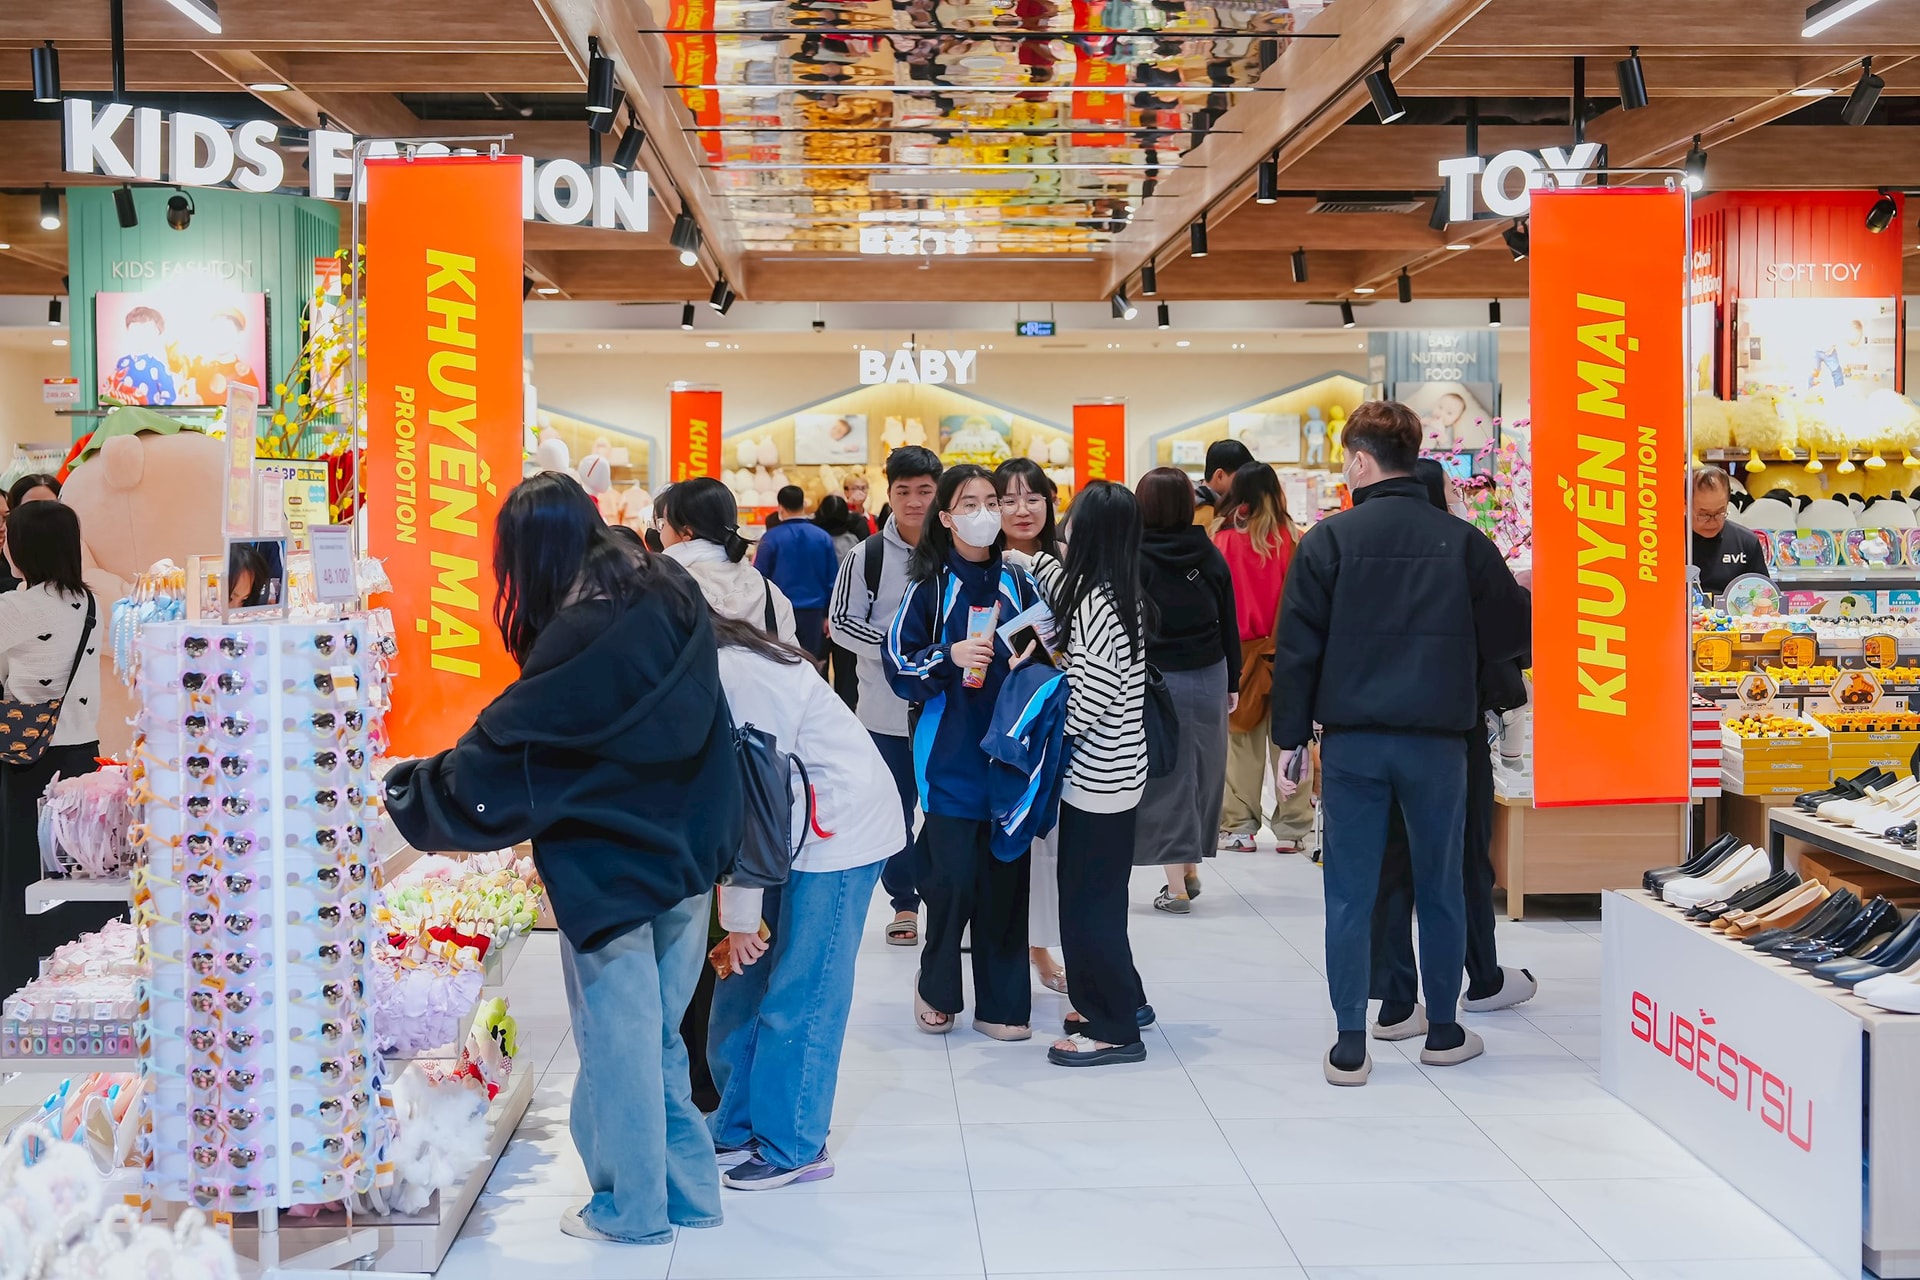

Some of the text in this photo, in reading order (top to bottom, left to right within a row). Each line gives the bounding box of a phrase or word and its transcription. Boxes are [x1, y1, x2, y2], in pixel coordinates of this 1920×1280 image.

[64, 98, 284, 193] KIDS
[1438, 142, 1602, 221] TOY
[112, 260, 154, 279] KIDS
[1766, 263, 1863, 283] SOFT TOY
[1411, 351, 1477, 364] NUTRITION
[1427, 335, 1460, 348] BABY
[859, 349, 977, 385] BABY
[1424, 367, 1463, 381] FOOD
[394, 384, 417, 544] PROMOTION
[416, 248, 497, 679] KHUYẾN MẠI
[1557, 292, 1640, 717] KHUYẾN MẠI
[1637, 425, 1658, 583] PROMOTION
[1722, 552, 1747, 564] avt
